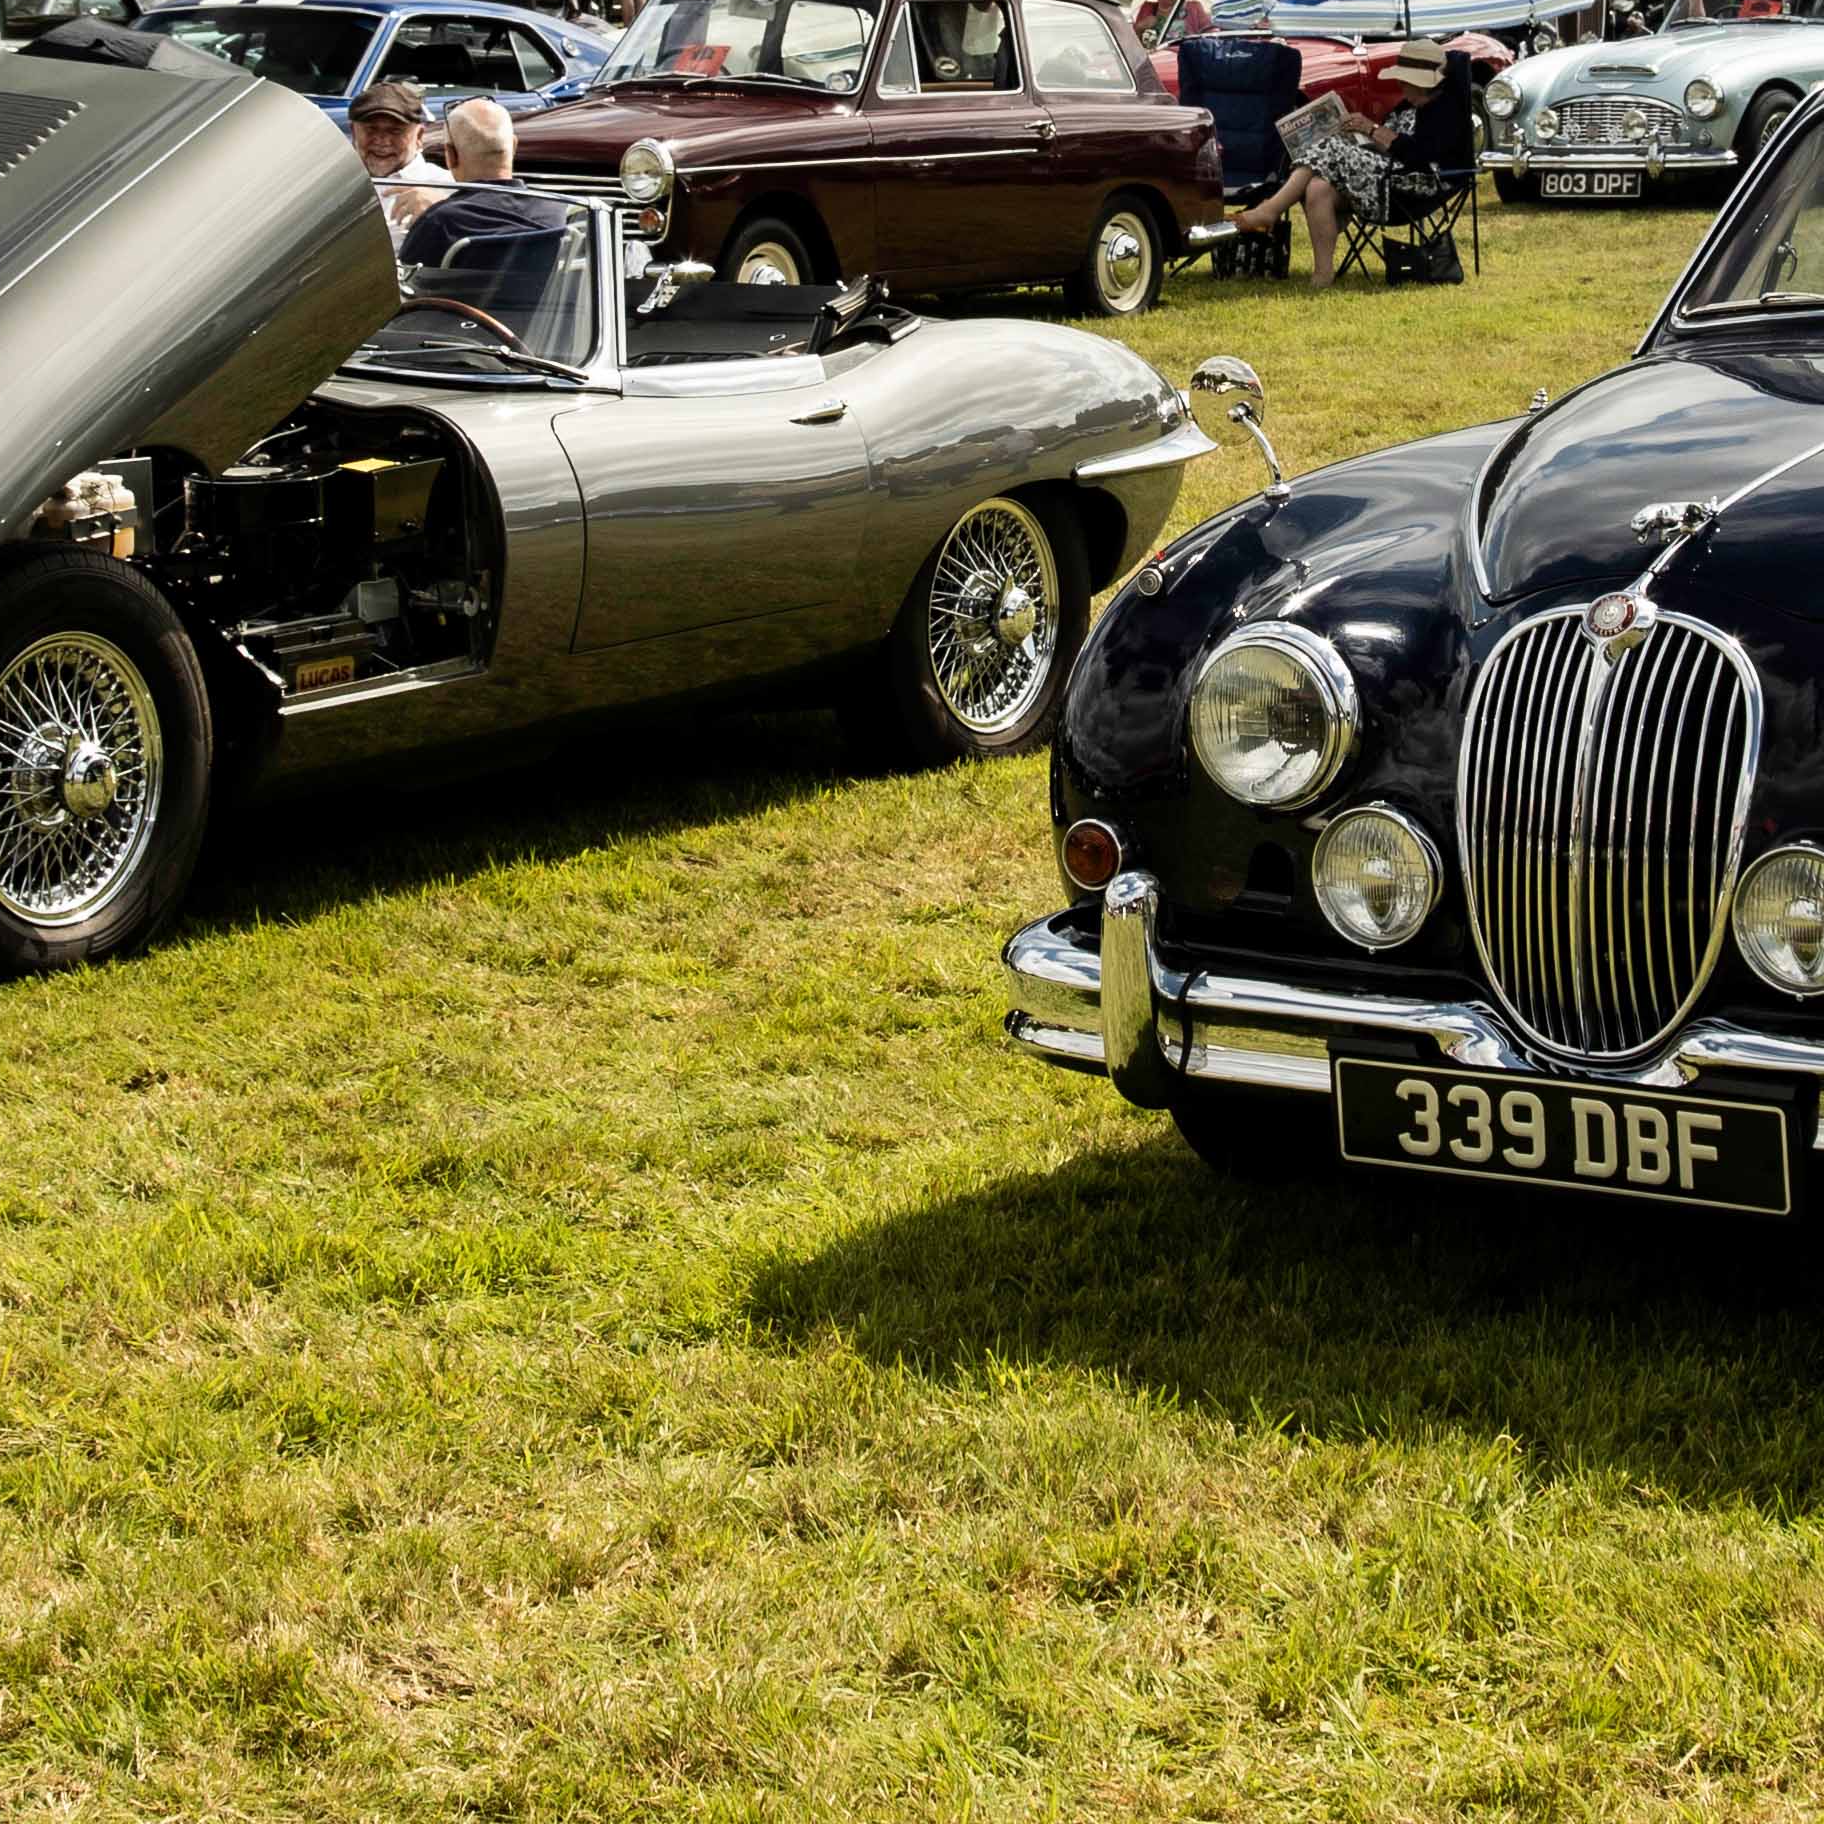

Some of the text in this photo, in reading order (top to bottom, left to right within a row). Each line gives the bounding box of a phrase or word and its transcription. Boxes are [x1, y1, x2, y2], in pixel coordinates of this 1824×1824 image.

[1545, 173, 1636, 194] 803 DPF
[300, 664, 352, 690] LUCAS
[1395, 1079, 1723, 1190] 339 DBF
